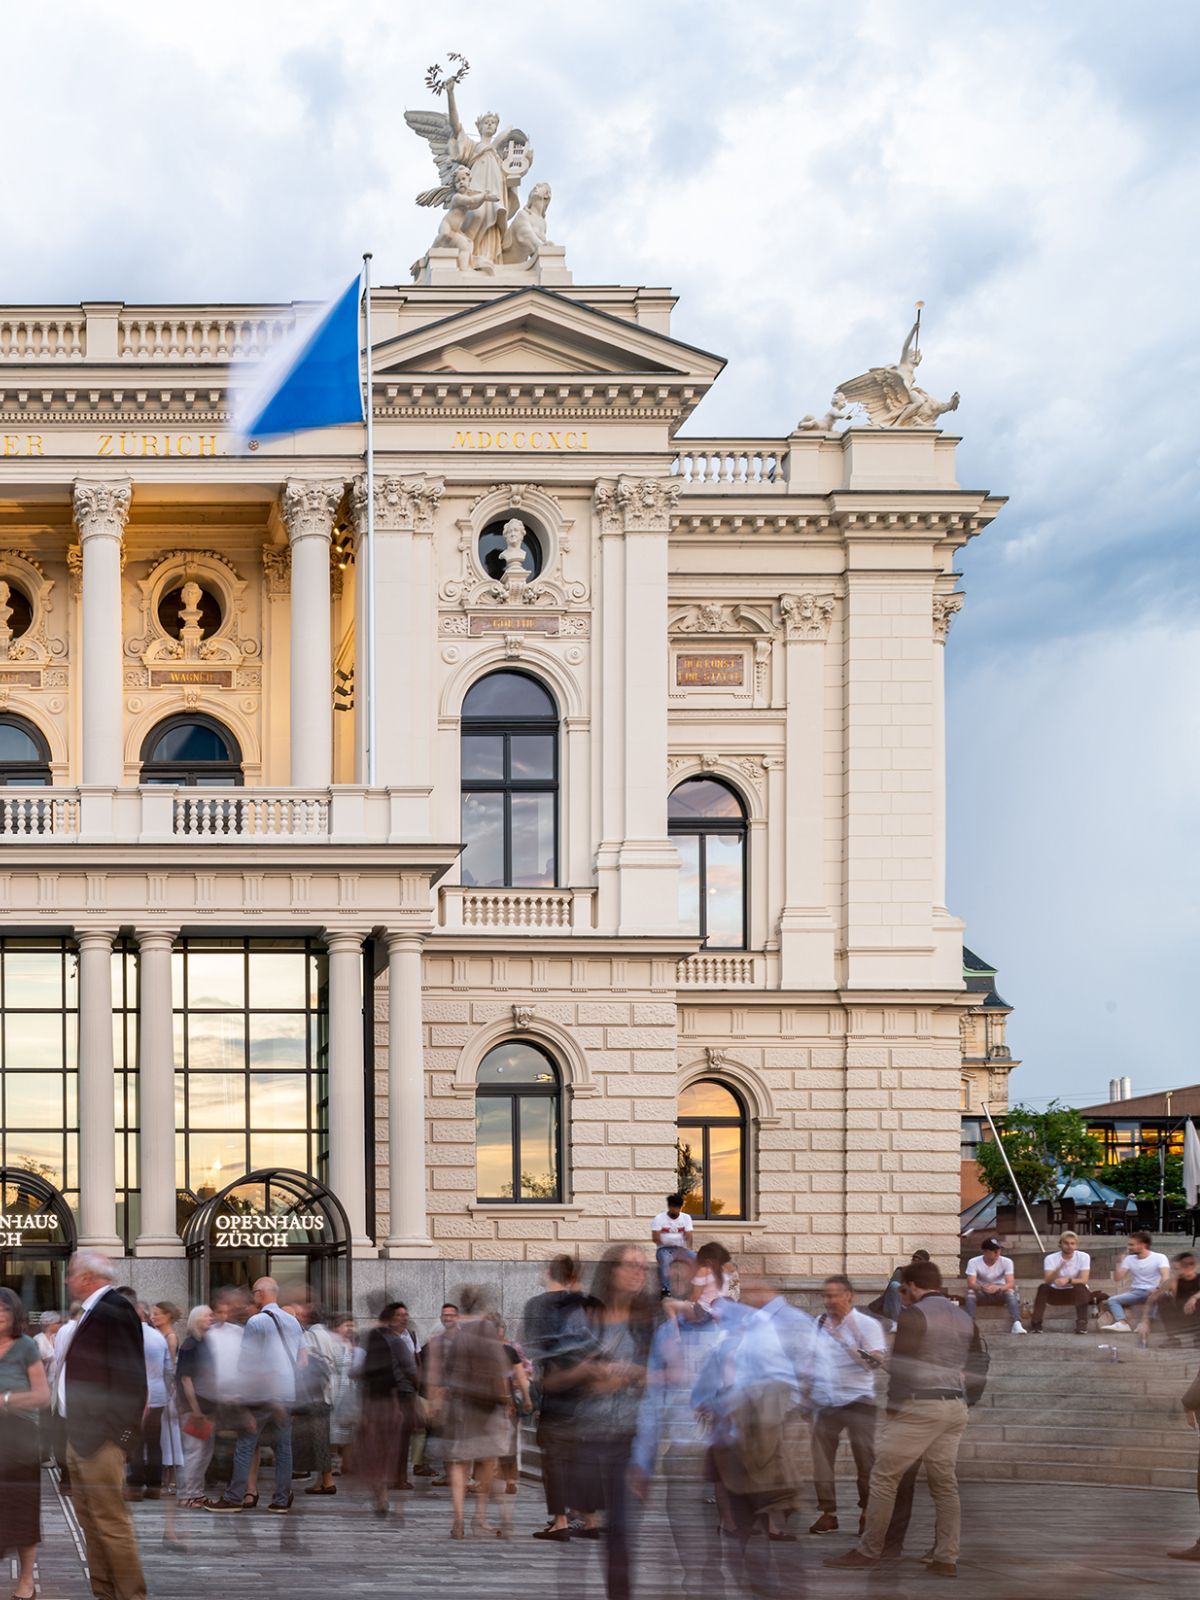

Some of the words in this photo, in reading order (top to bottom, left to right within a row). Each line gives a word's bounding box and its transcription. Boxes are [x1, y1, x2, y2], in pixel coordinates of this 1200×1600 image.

[451, 431, 588, 449] MDCCCXCI
[215, 1215, 324, 1230] OPERNHAUS
[215, 1230, 289, 1247] ZÜRICH
